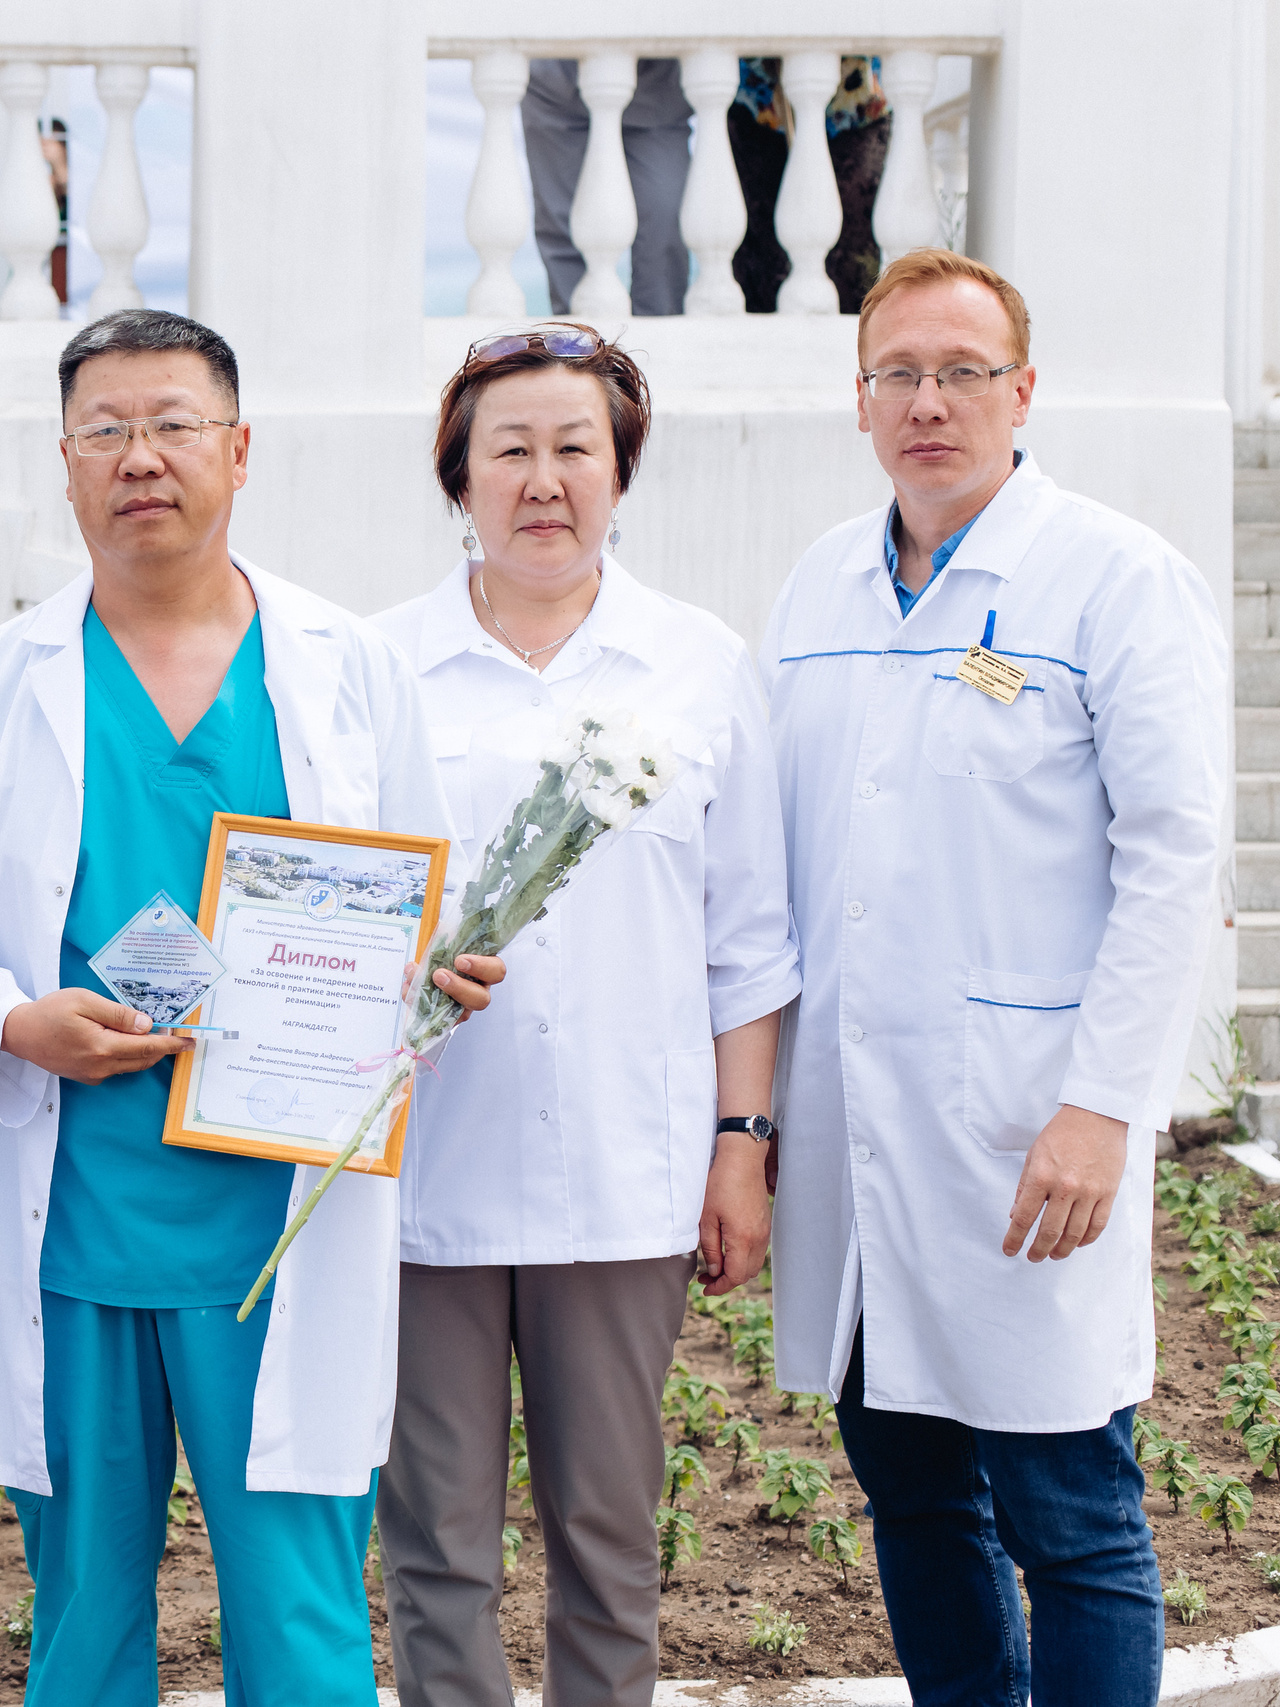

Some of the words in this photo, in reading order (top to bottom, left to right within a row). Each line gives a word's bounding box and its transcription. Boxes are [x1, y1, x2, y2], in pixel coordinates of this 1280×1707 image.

[267, 943, 356, 972] Диплом
[106, 965, 145, 973] Филимонов
[147, 967, 171, 975] Виктор
[173, 969, 212, 977] Андреевич
[250, 968, 264, 976] «За
[266, 971, 304, 980] освоение
[312, 977, 356, 988] внедрение
[358, 983, 384, 991] новых
[234, 978, 279, 989] технологий
[287, 986, 324, 995] практике
[326, 990, 390, 1004] анестезиологии
[285, 997, 341, 1008] реанимации»
[282, 1020, 337, 1033] НАГРАЖДАЕТСЯ
[257, 1044, 293, 1054] Филимонов
[294, 1049, 319, 1058] Виктор
[320, 1053, 354, 1062] Андреевич
[227, 1064, 259, 1073] Отделения
[260, 1070, 295, 1079] реанимации
[301, 1076, 339, 1086] интенсивной
[340, 1081, 366, 1089] терапии
